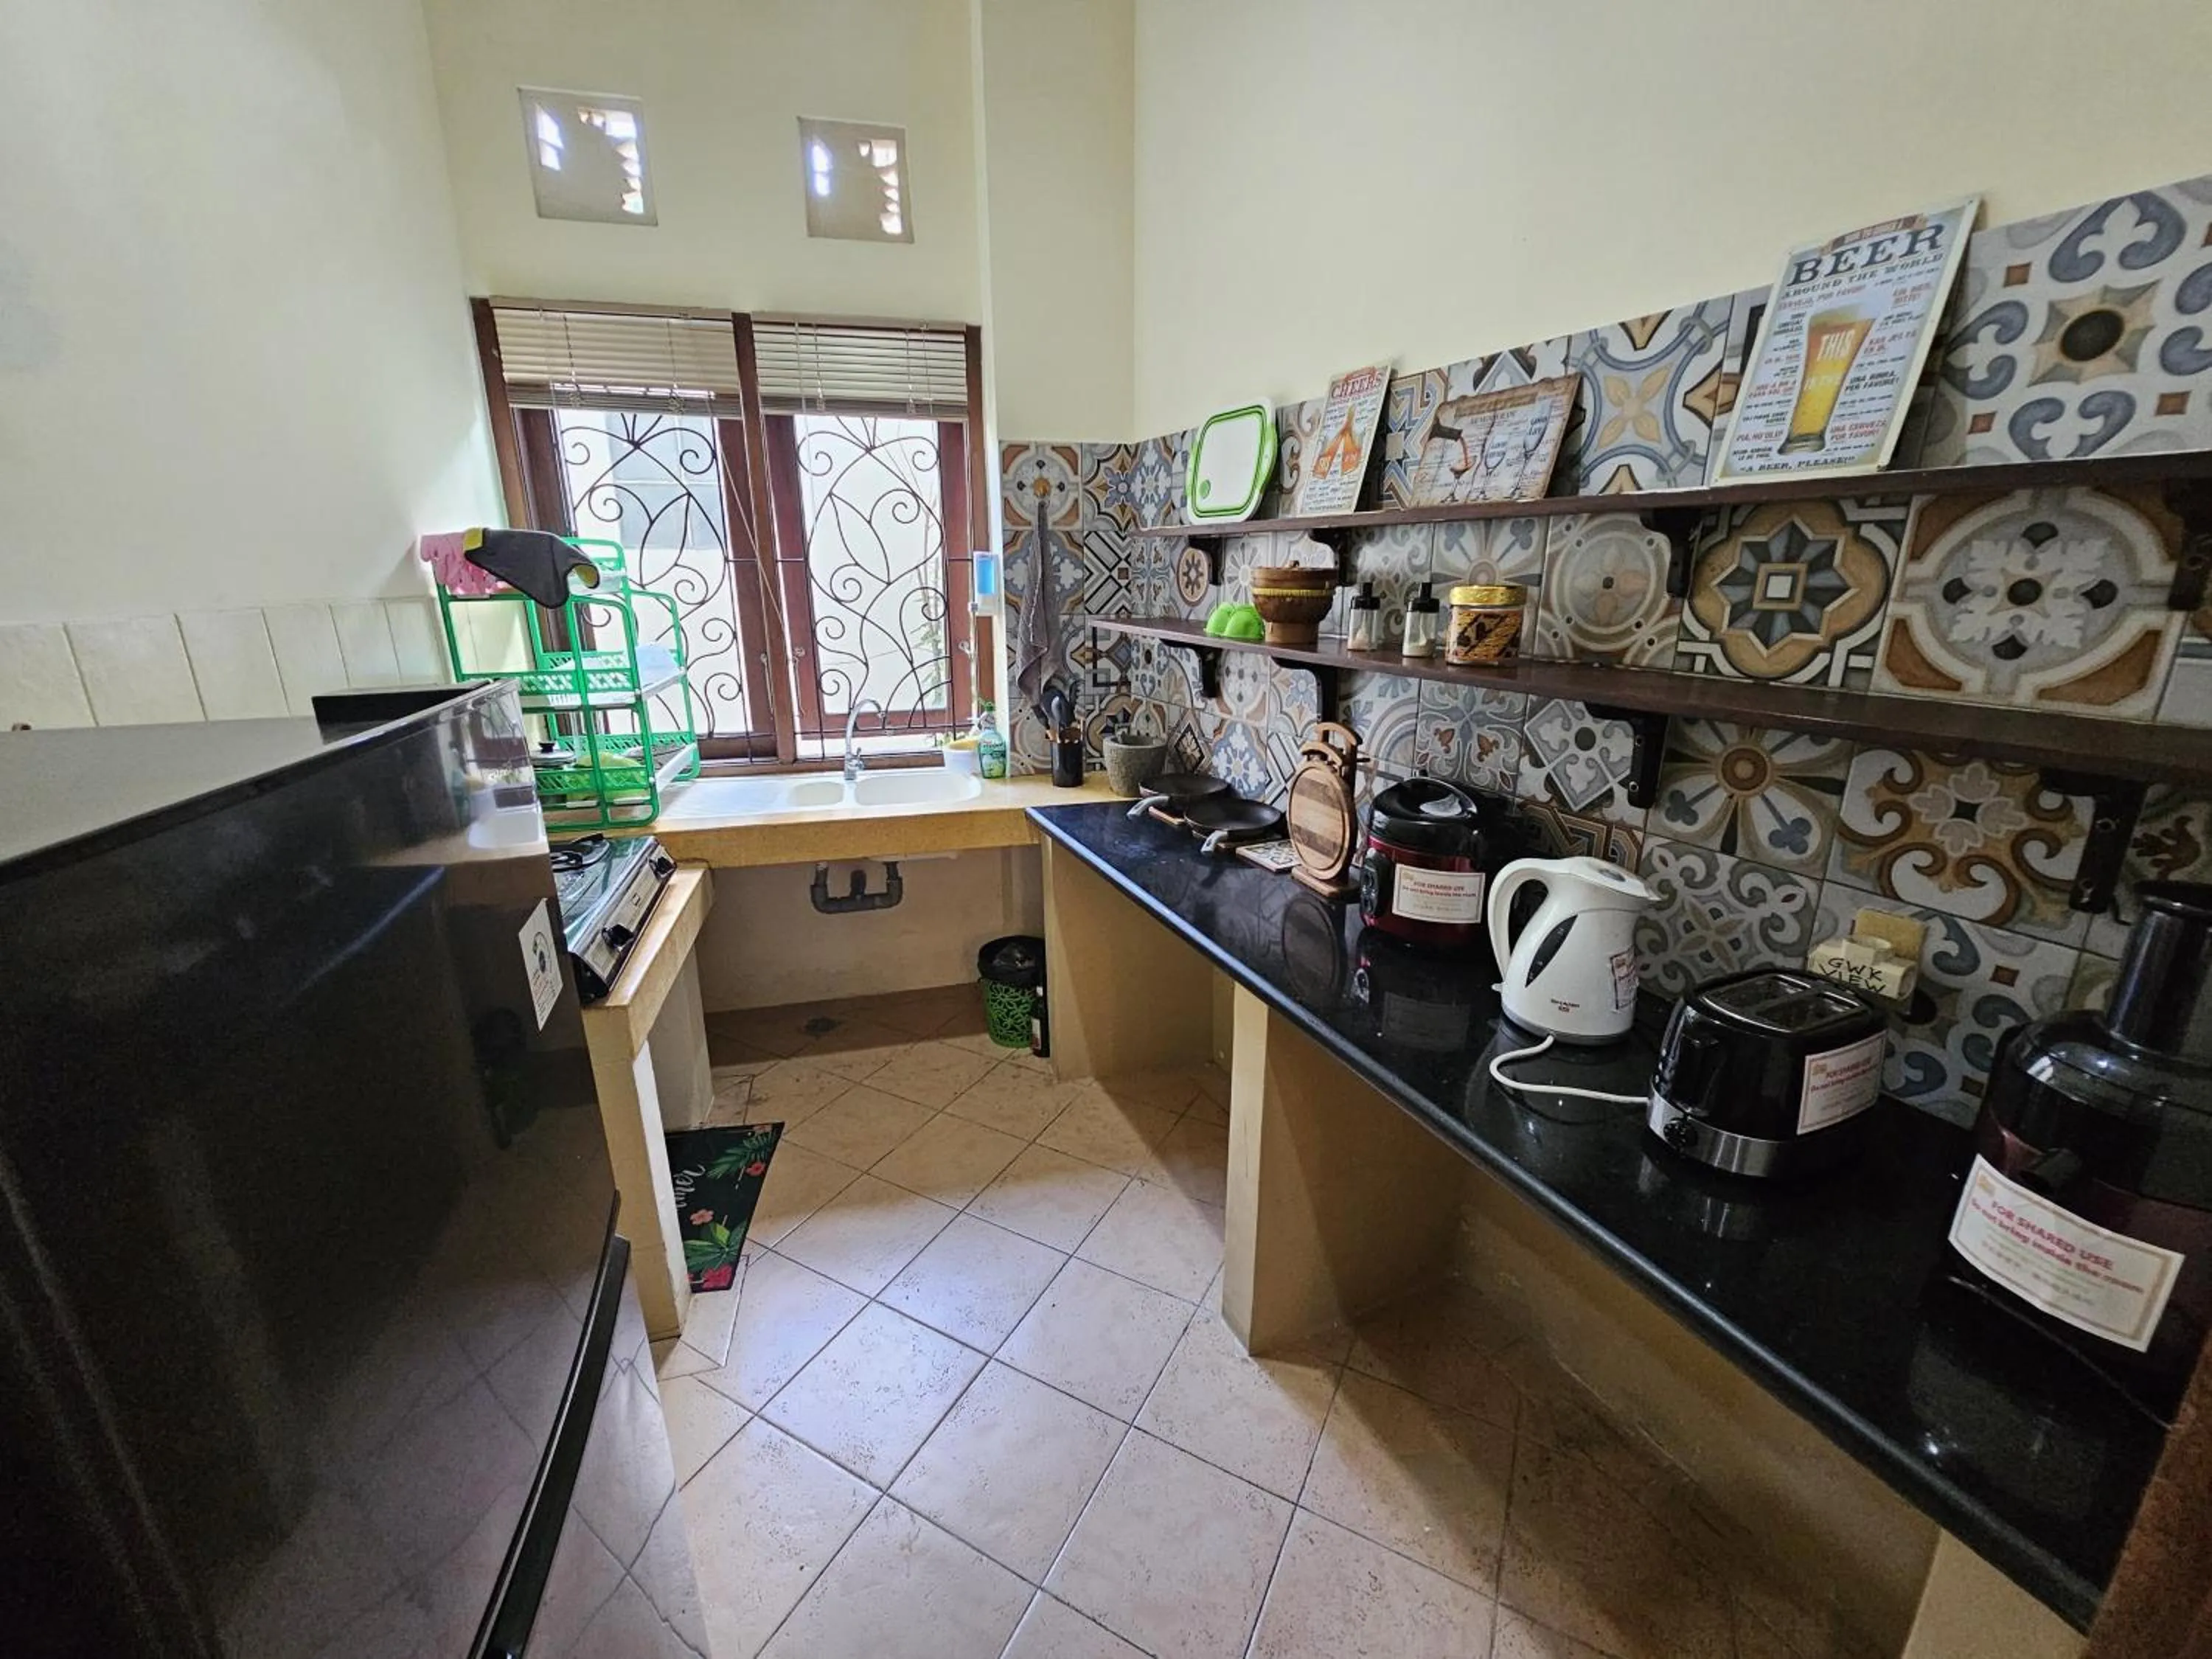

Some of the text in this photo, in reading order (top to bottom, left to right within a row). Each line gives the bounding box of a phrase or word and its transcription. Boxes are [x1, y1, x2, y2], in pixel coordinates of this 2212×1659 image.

[1787, 223, 1945, 286] BEER
[1781, 279, 1843, 299] AROUND
[1848, 271, 1879, 283] THE
[1885, 253, 1944, 274] WORLD
[1817, 329, 1856, 361] THIS
[1332, 372, 1382, 399] CHEERS
[1818, 963, 1886, 992] VIEW
[1992, 1200, 2114, 1270] FOR SHARED USE
